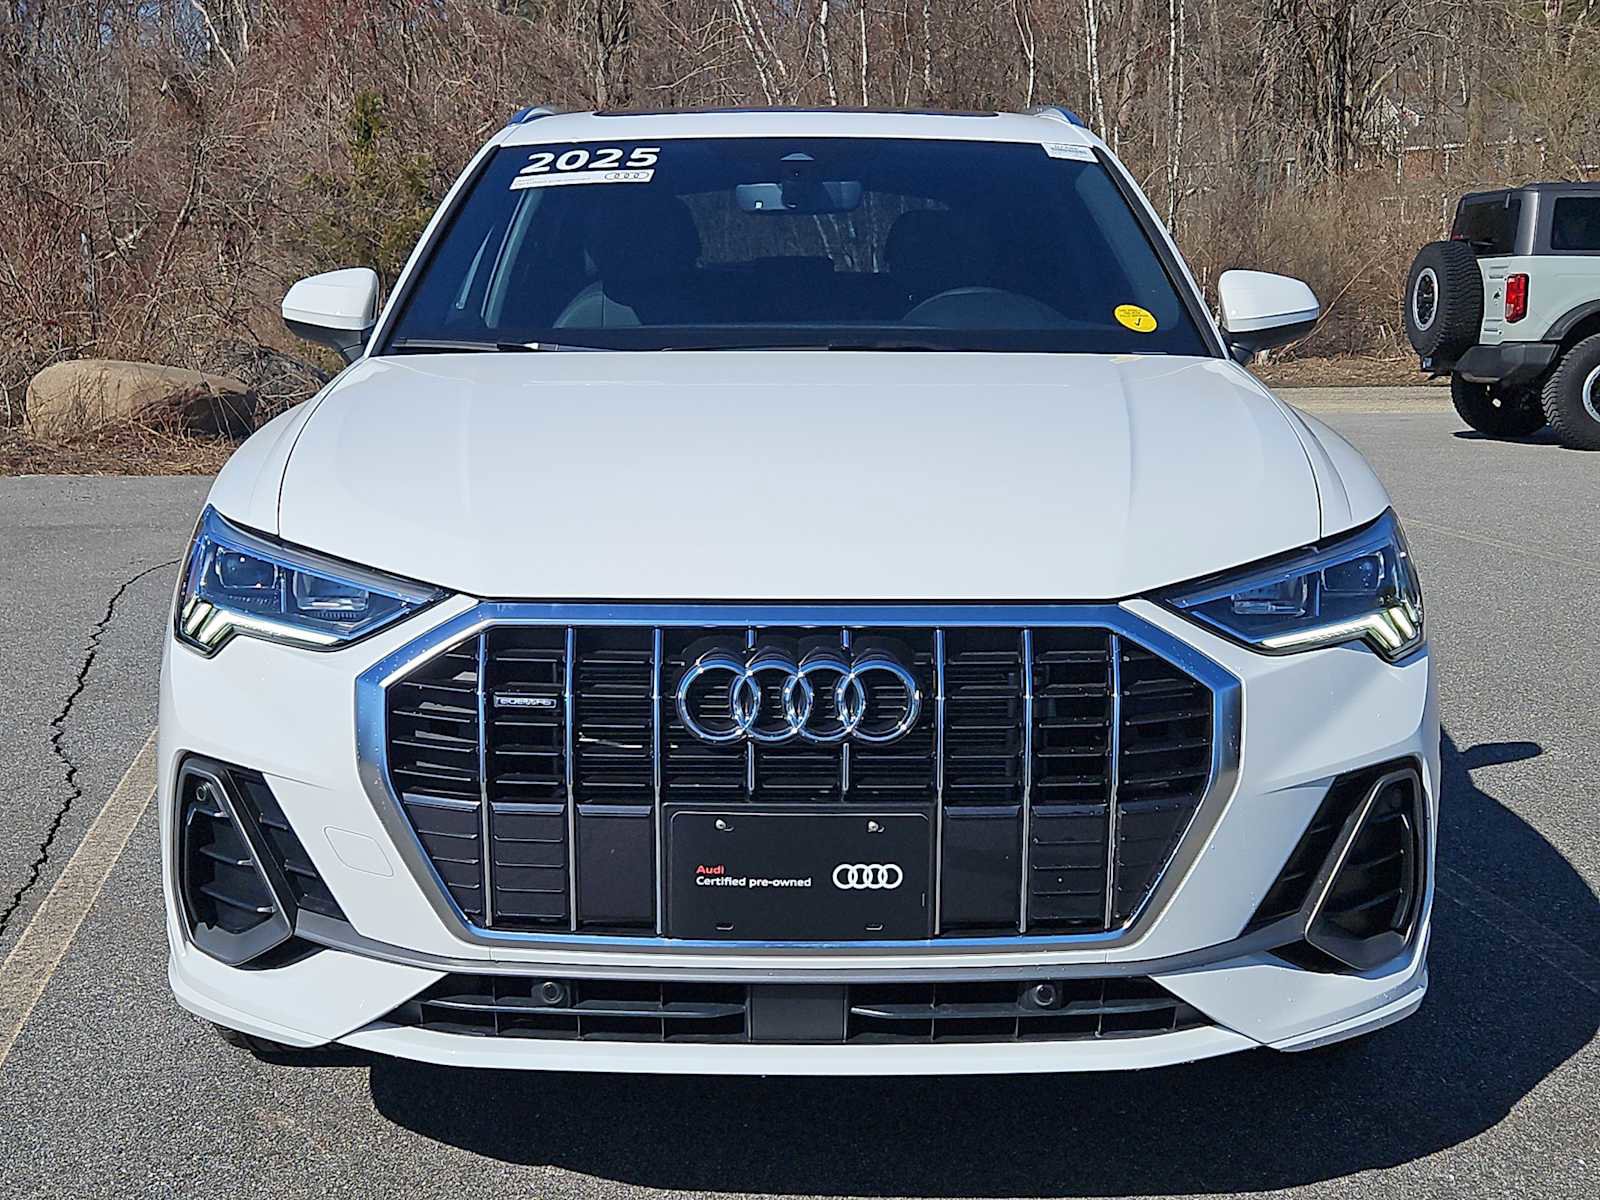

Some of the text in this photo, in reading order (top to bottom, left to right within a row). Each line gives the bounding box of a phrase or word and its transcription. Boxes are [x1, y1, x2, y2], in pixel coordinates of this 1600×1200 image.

[519, 147, 661, 175] 2025
[696, 865, 725, 875] Audi
[696, 876, 812, 889] Certified pre-owned
